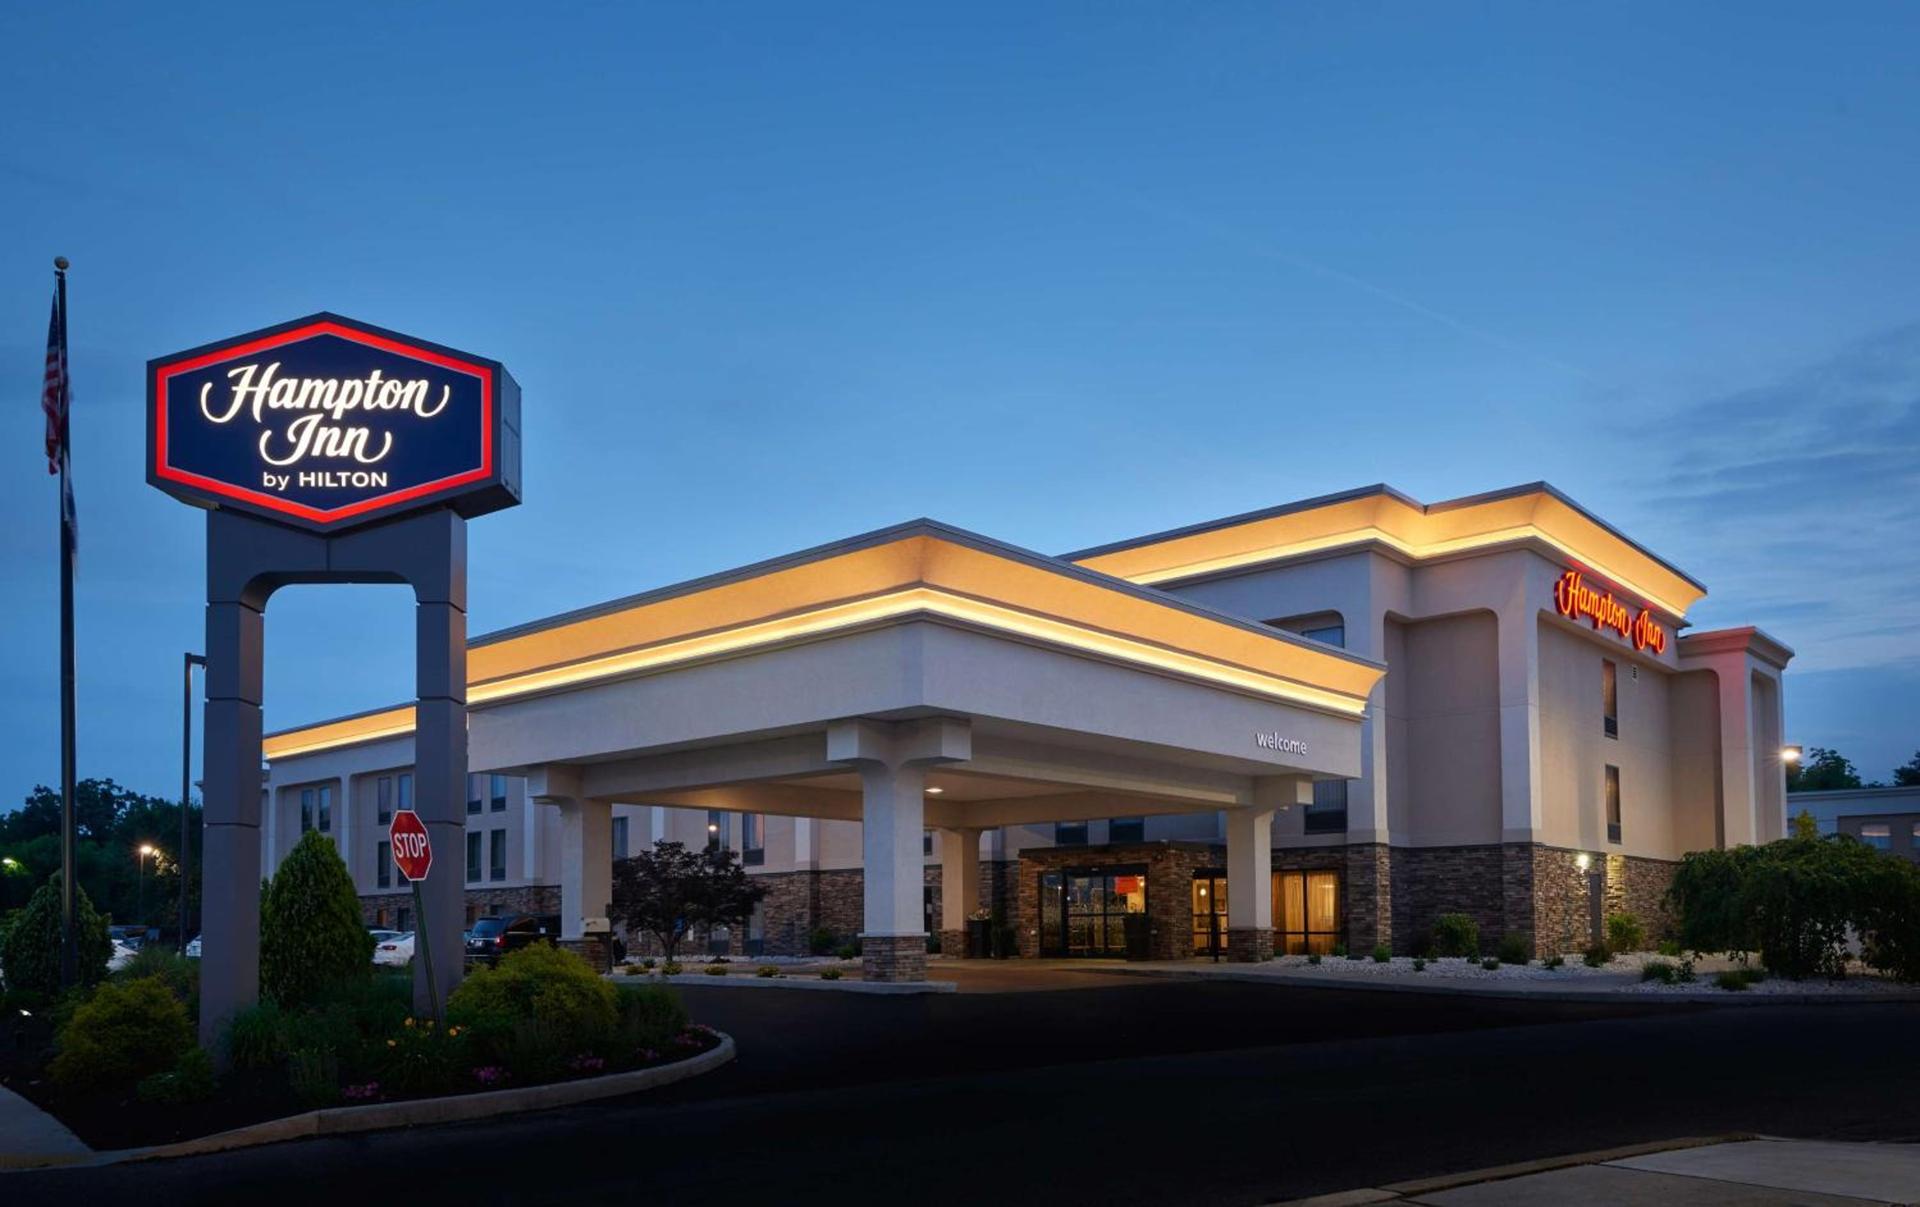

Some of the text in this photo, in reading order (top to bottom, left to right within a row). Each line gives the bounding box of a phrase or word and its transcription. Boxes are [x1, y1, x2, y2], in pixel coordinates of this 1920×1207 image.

[200, 362, 450, 423] Hampton
[259, 413, 393, 466] Inn
[263, 471, 388, 491] by HILTON
[1557, 570, 1665, 654] Hampton Inn
[1256, 731, 1307, 755] welcome
[394, 832, 427, 858] STOP
